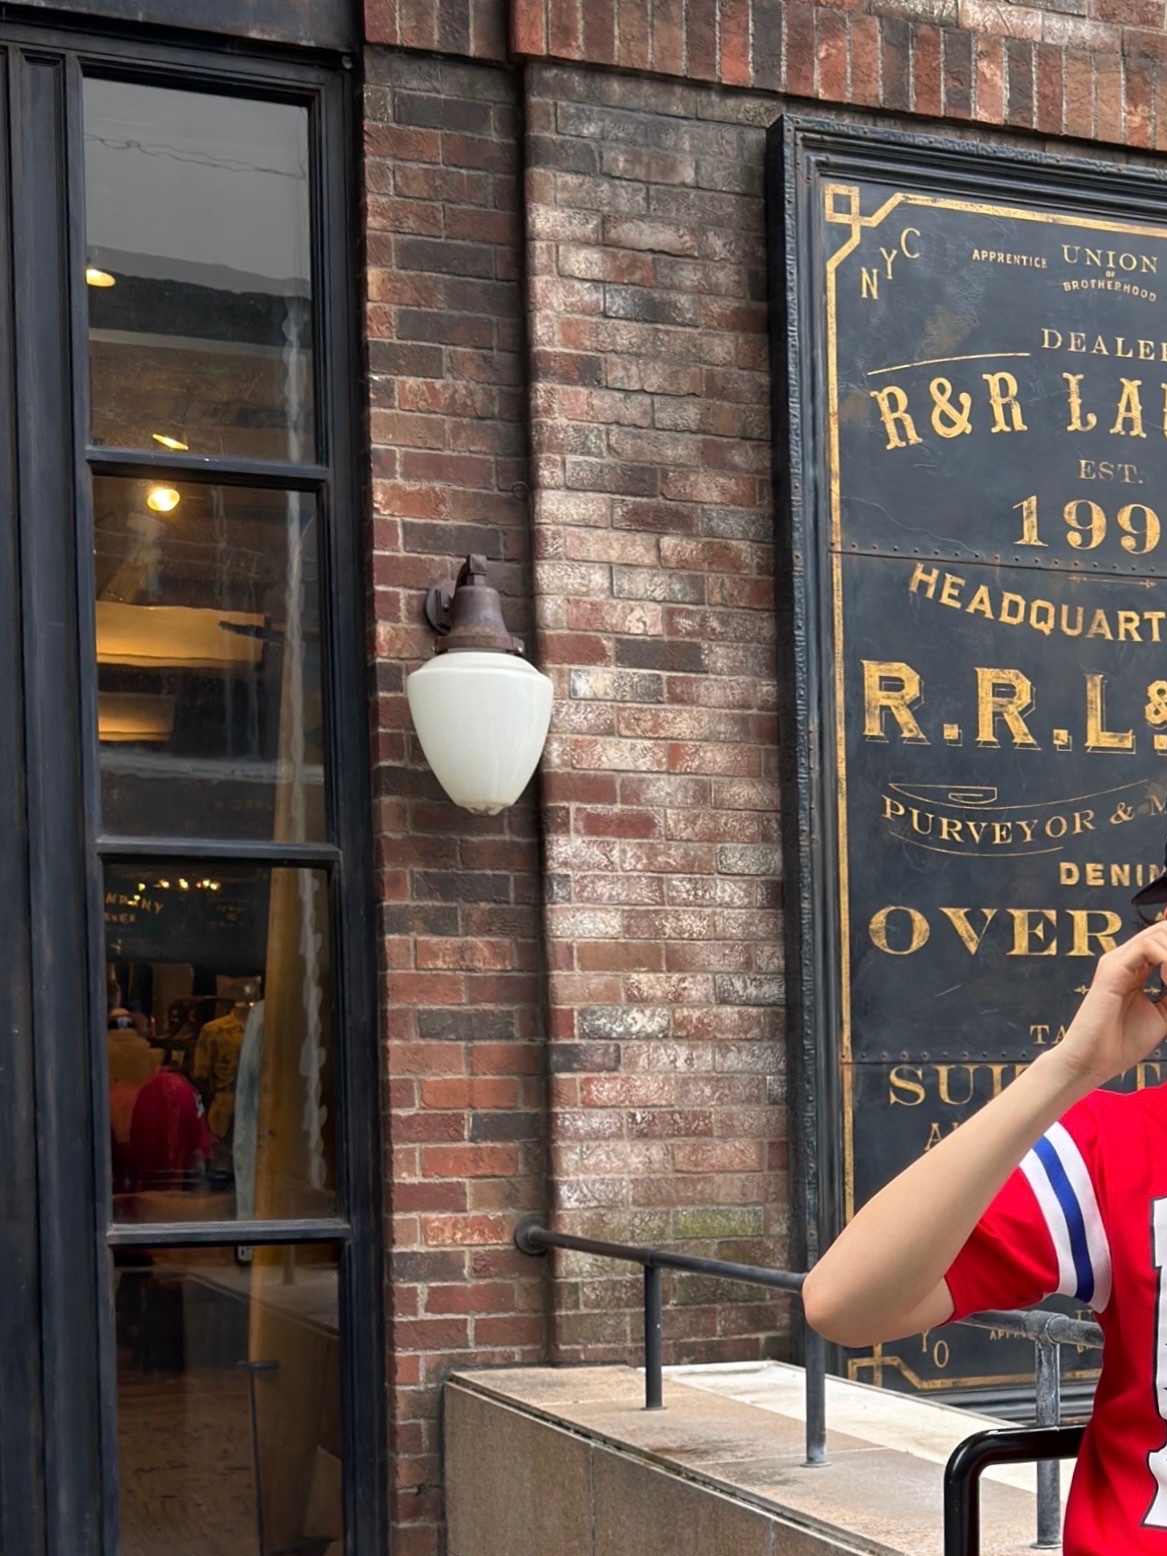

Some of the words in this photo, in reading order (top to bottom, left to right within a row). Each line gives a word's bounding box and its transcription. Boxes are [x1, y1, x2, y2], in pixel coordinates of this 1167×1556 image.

[860, 227, 921, 300] NYC
[972, 249, 1048, 269] APPRENTICE
[1061, 244, 1159, 274] UNION
[1063, 278, 1158, 302] BROTHERHOOD
[1105, 271, 1116, 279] OF
[869, 371, 1028, 451] R&R
[1077, 458, 1144, 486] EST.
[882, 795, 1097, 846] PURVEYOR
[1108, 801, 1136, 826] &
[868, 904, 1165, 958] OVER
